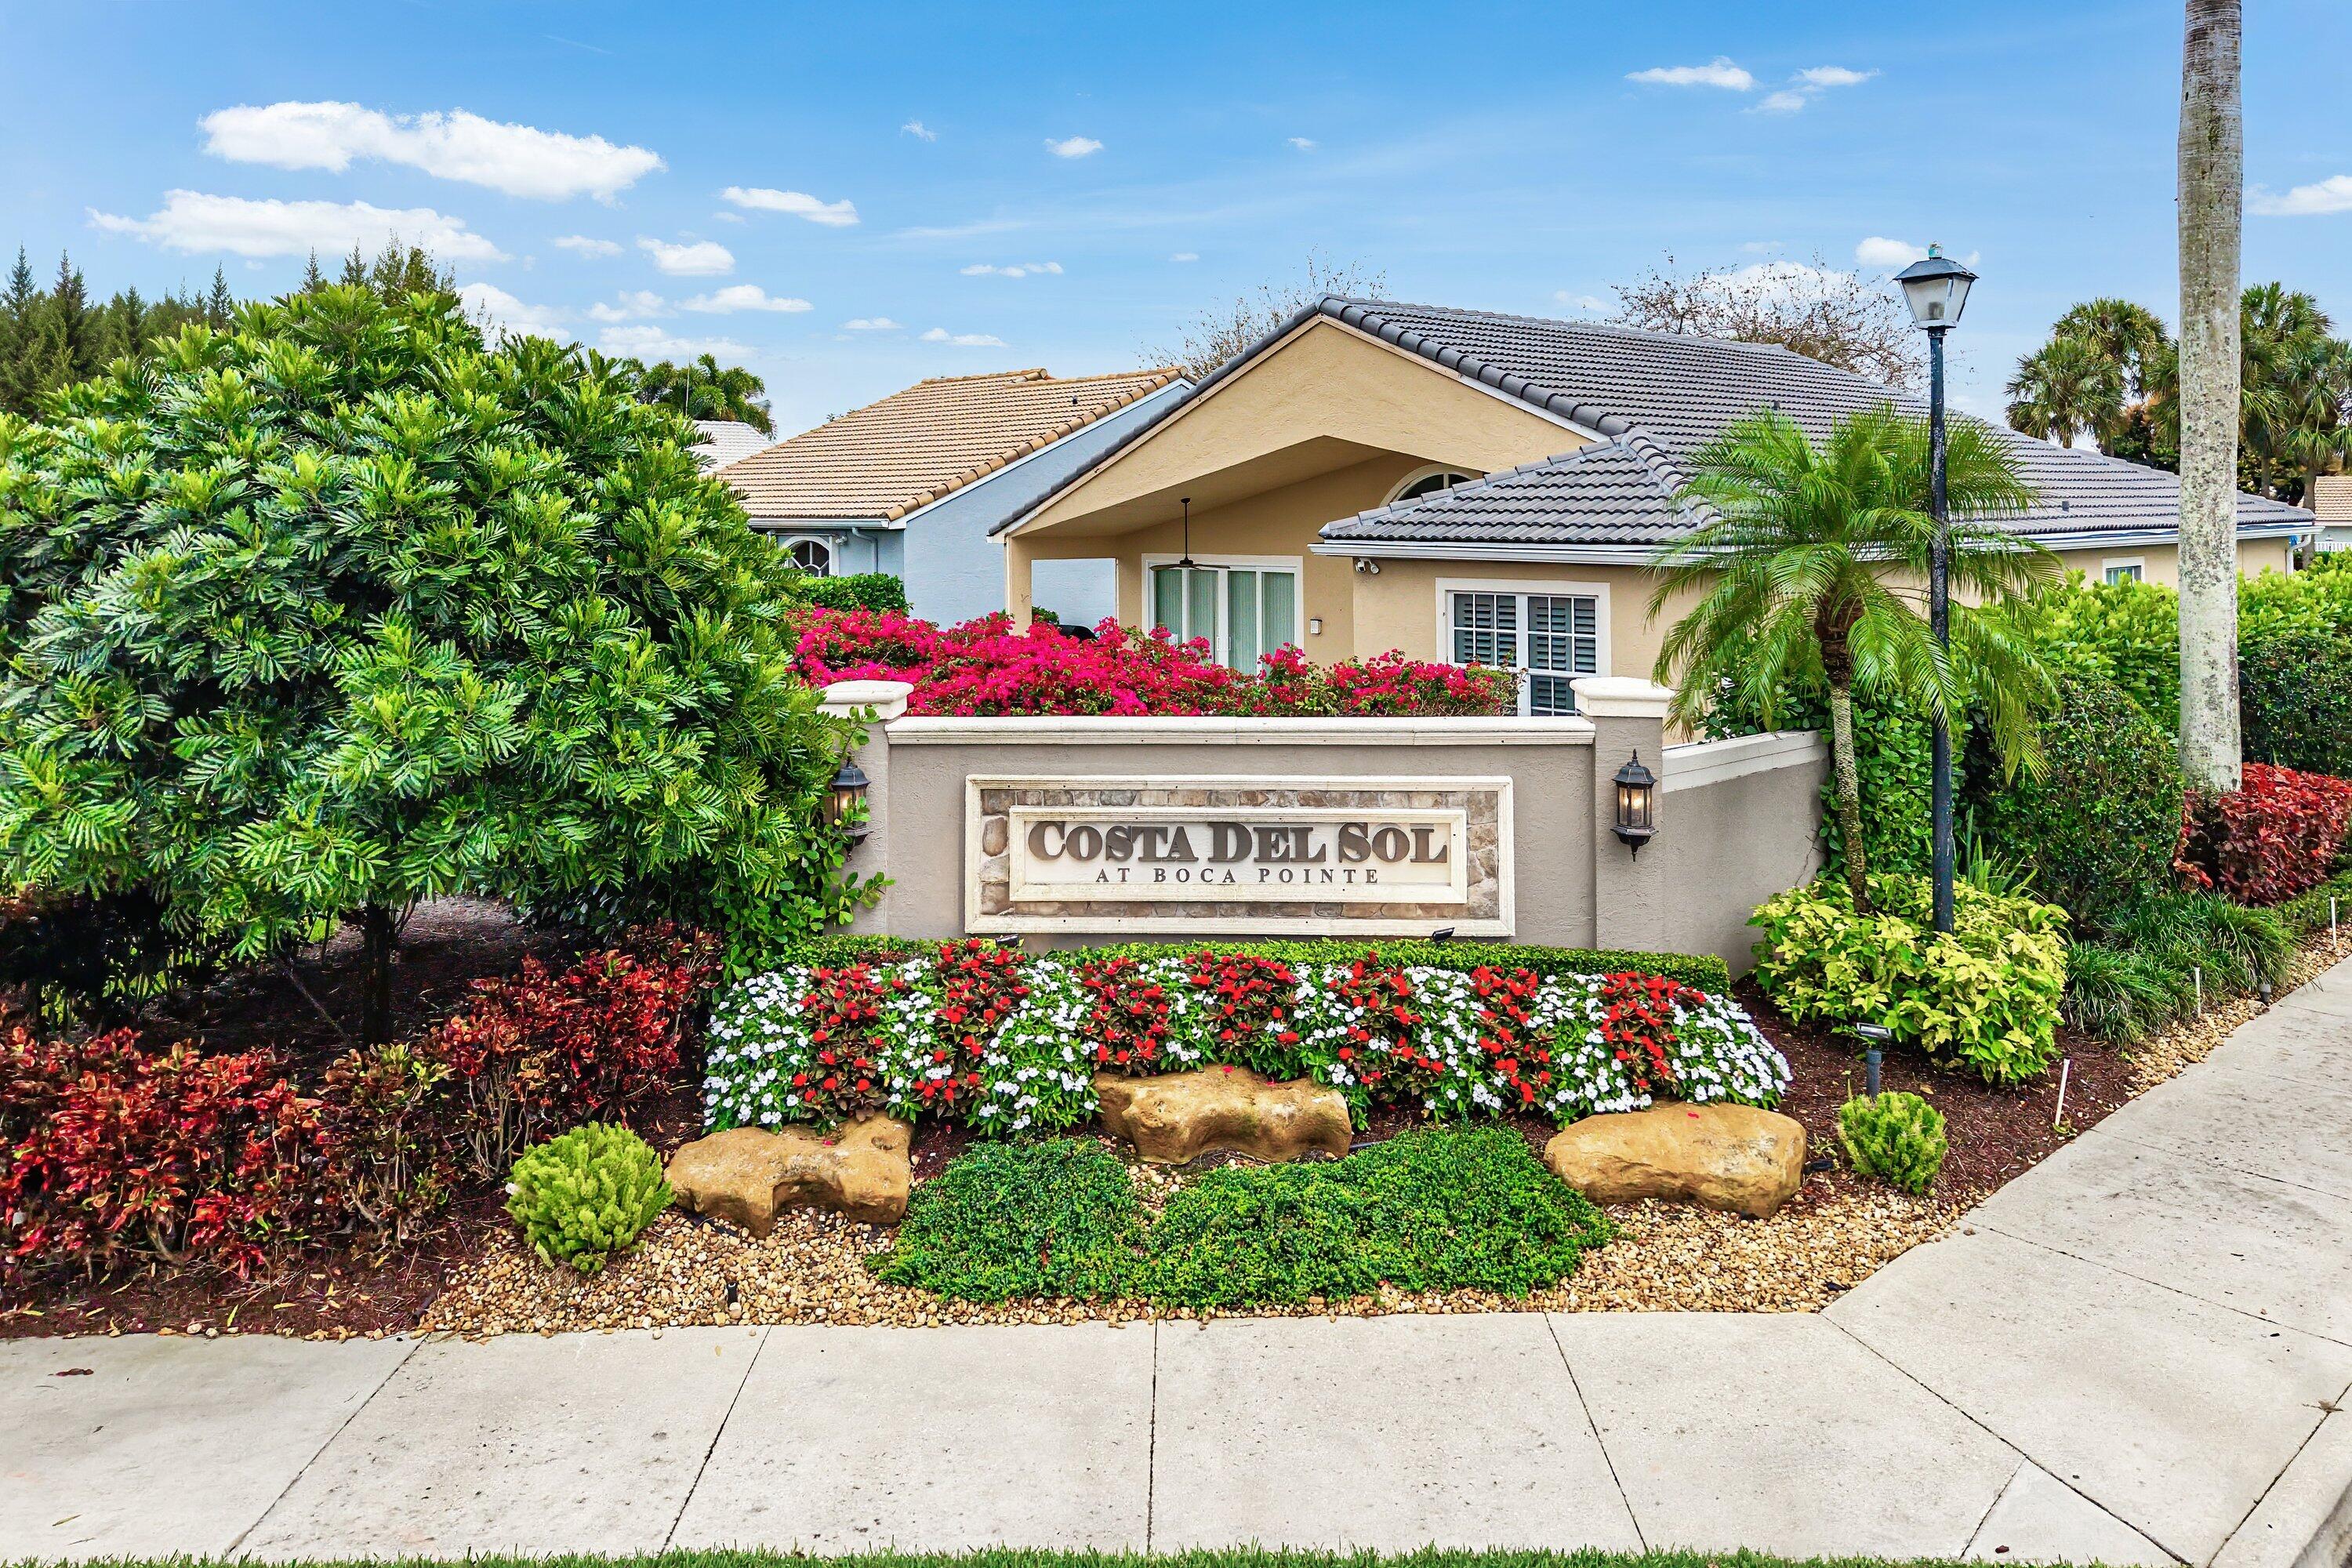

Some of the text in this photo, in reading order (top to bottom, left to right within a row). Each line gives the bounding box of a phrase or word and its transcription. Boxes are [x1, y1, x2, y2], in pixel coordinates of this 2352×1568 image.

[1028, 821, 1447, 863] COSTA DEL SOL
[1095, 868, 1378, 884] AT BOCA POINTE
